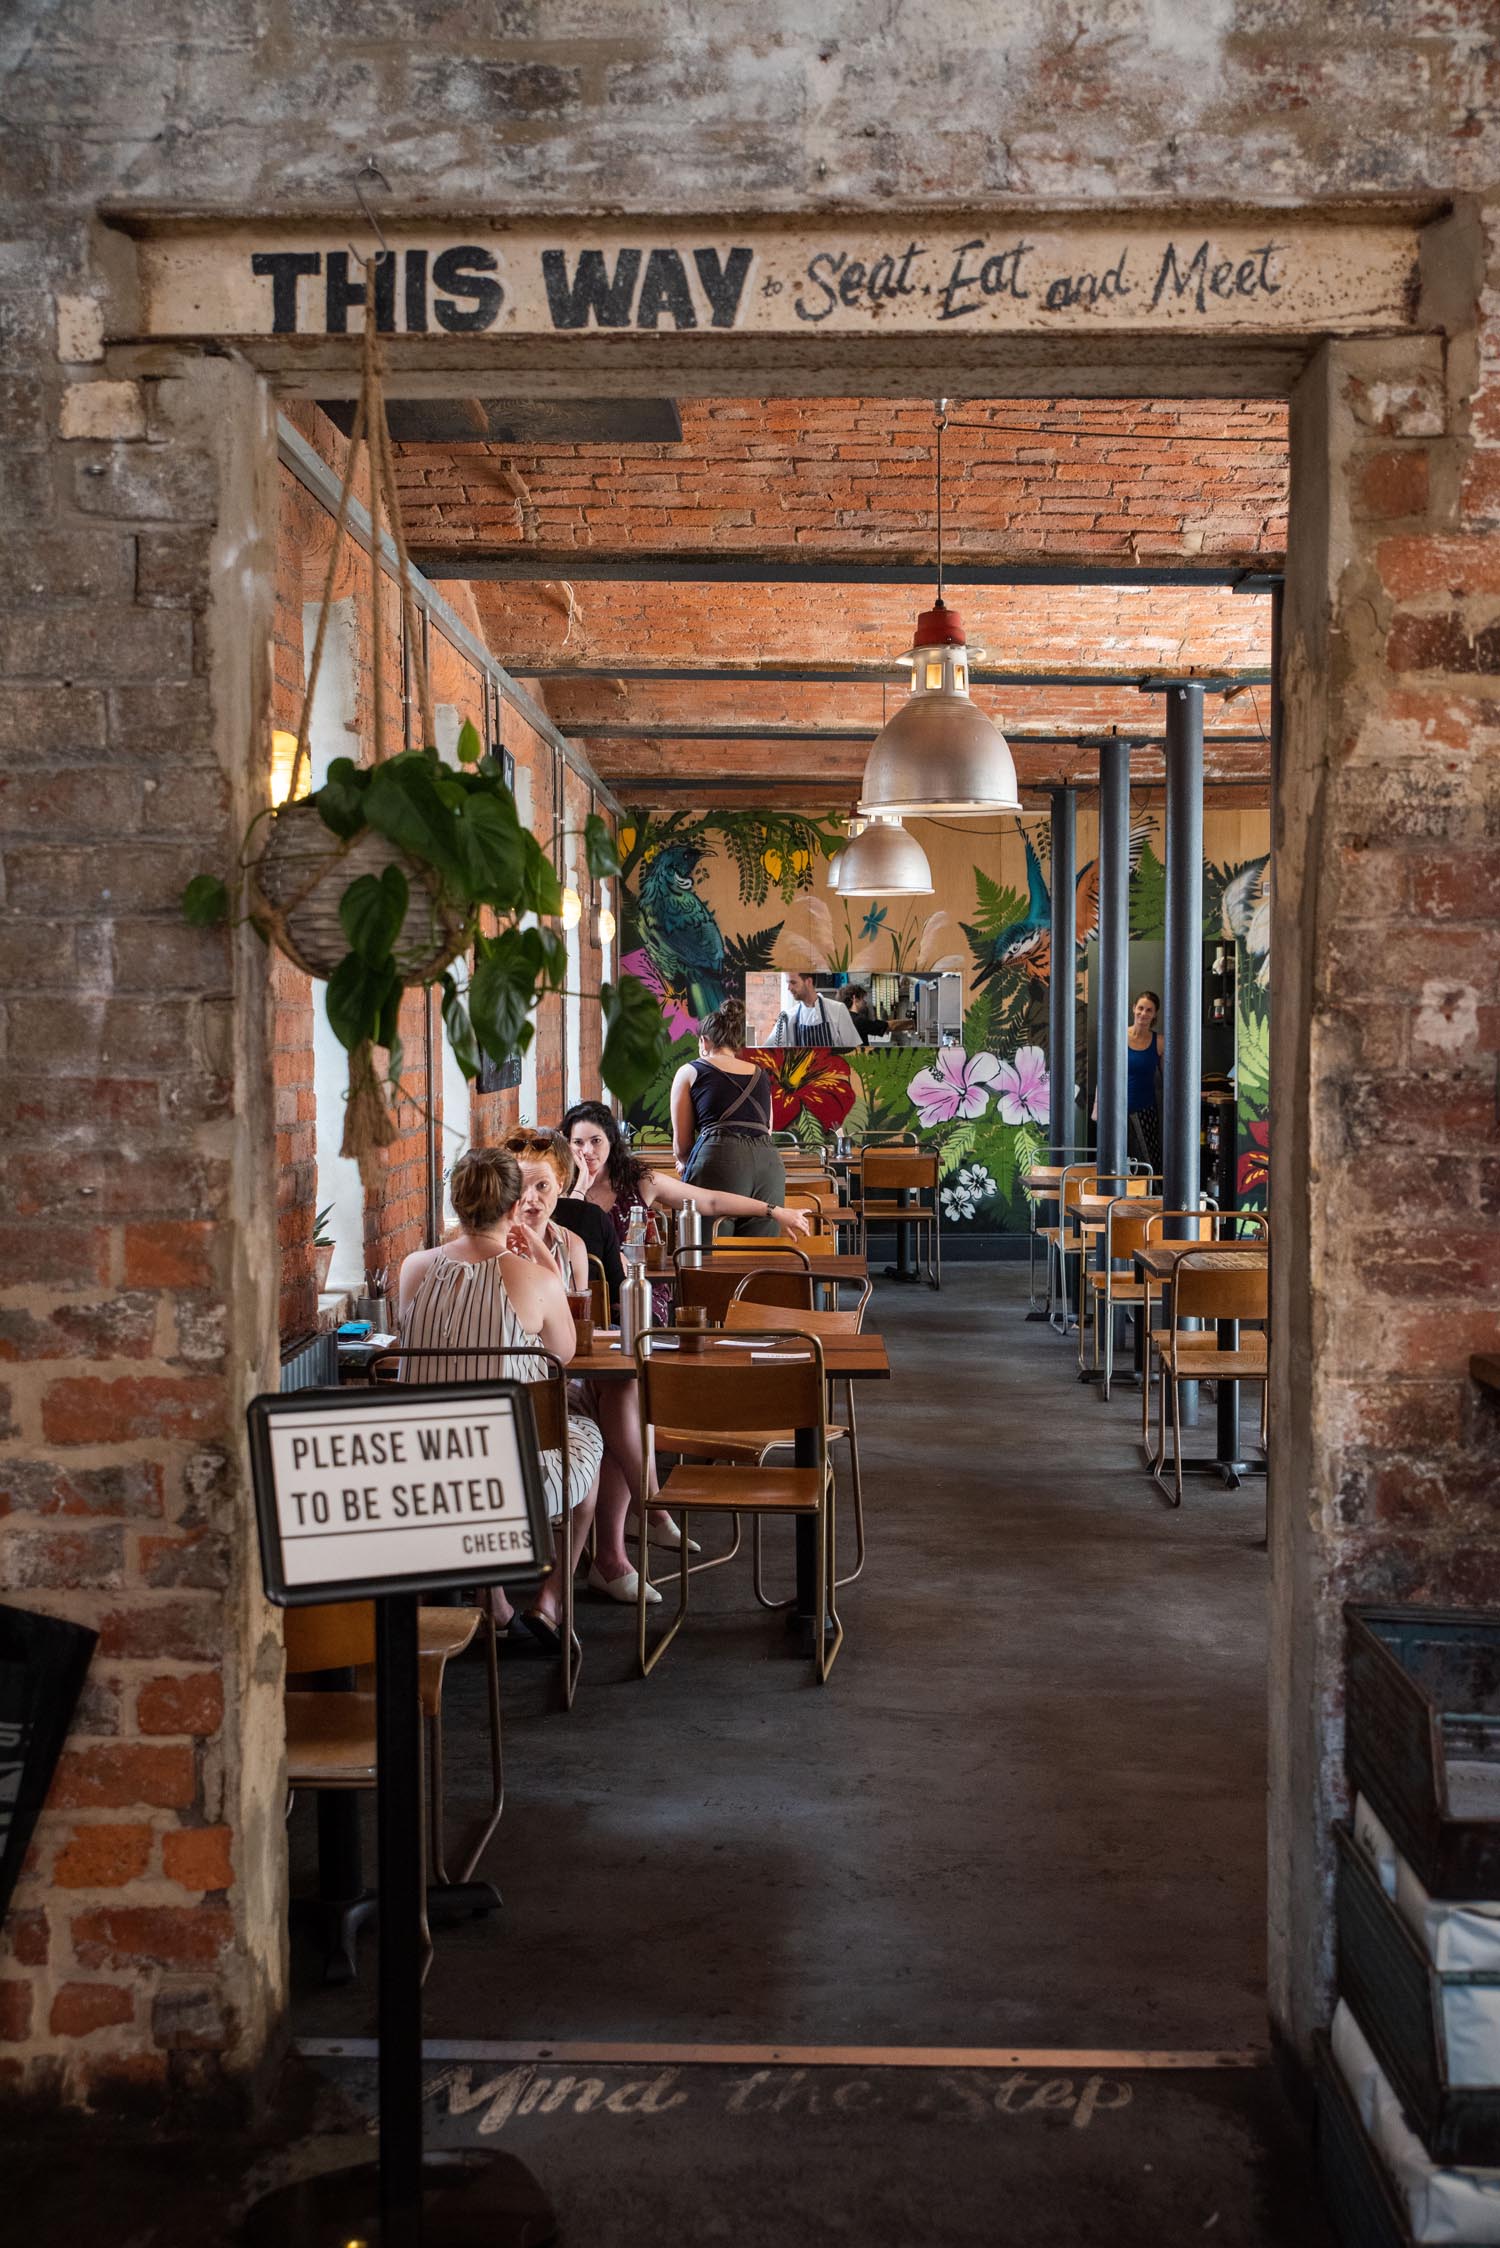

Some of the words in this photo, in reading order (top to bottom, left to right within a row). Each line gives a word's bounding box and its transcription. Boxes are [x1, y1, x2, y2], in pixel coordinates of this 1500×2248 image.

[251, 246, 506, 334] THIS
[540, 247, 754, 331] WAY
[761, 274, 784, 298] to
[936, 239, 1035, 320] Eat
[1044, 247, 1131, 311] and
[1150, 240, 1290, 315] Meet
[292, 1431, 407, 1470] PLEASE
[417, 1425, 490, 1461] WAIT
[290, 1491, 330, 1526] TO
[342, 1487, 380, 1522] BE
[391, 1477, 505, 1518] SEATED
[462, 1529, 533, 1555] CHEERS
